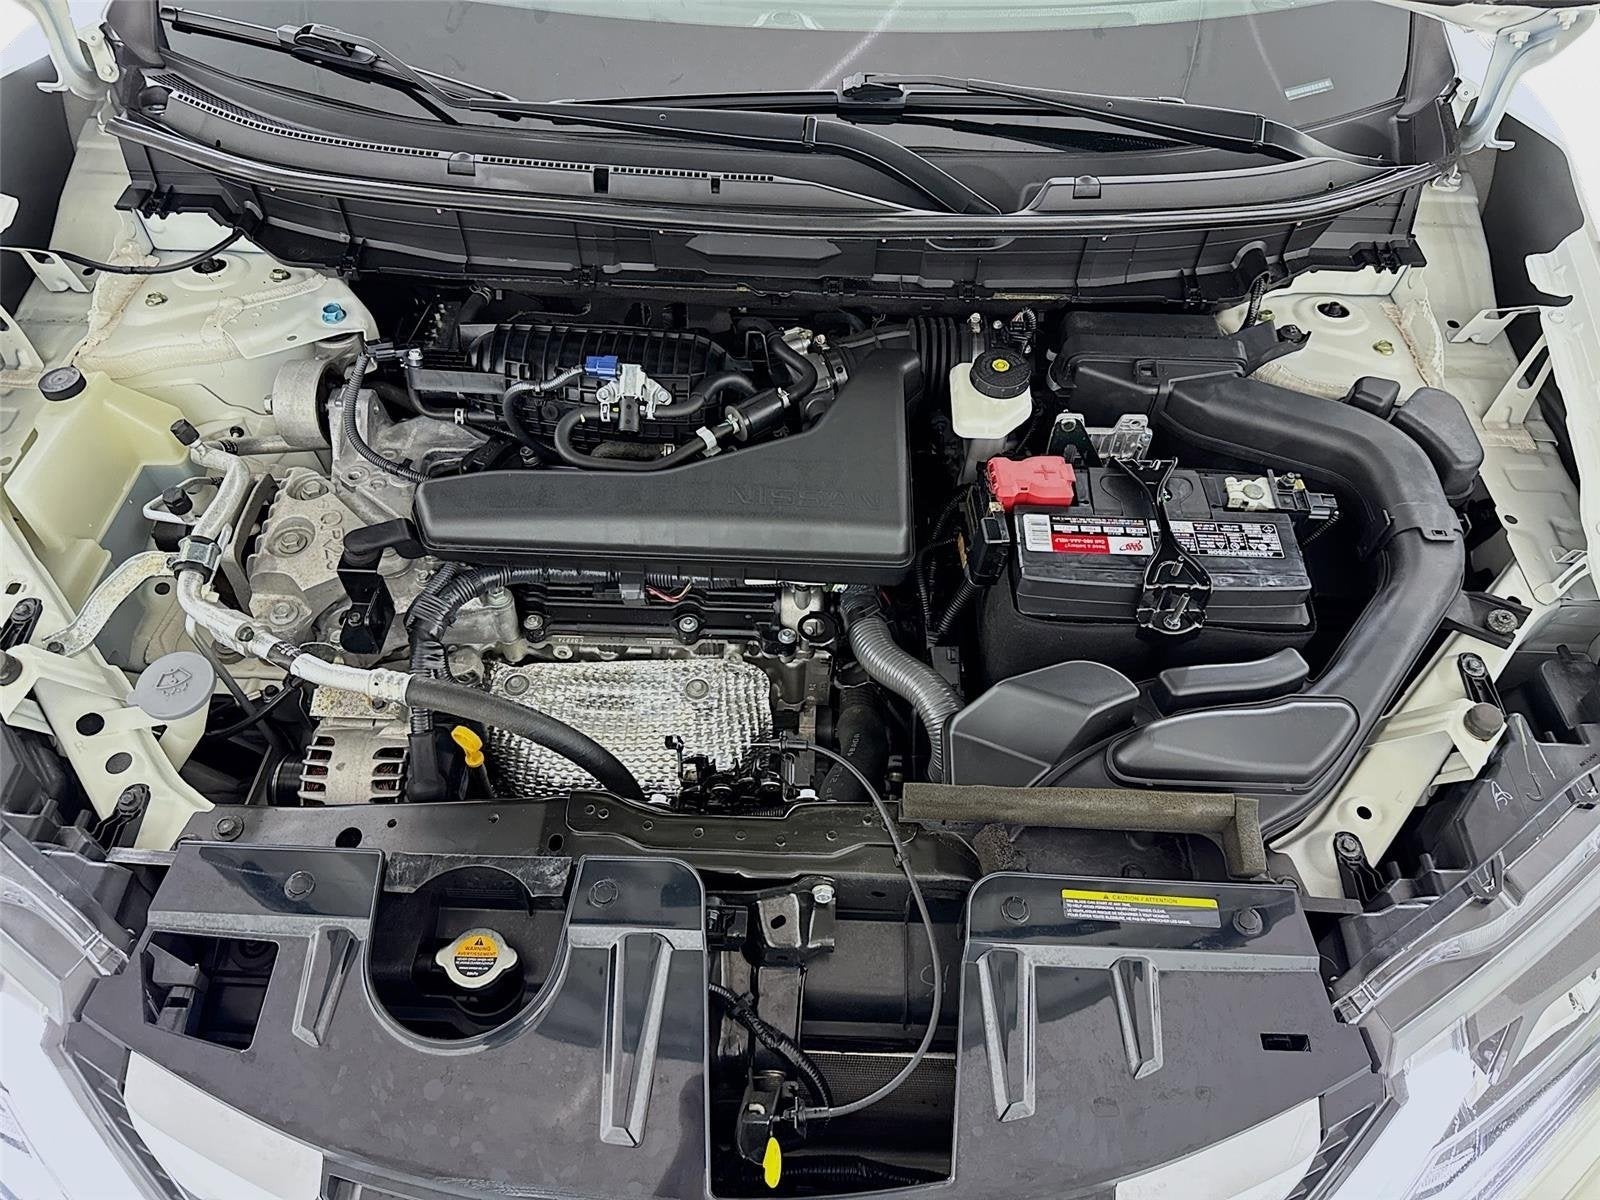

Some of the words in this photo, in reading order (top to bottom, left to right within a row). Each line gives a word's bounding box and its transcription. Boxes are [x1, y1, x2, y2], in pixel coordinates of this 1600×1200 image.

[728, 485, 882, 509] NISSAN
[1112, 894, 1140, 902] CAUTION
[1145, 896, 1178, 904] ATTENTION
